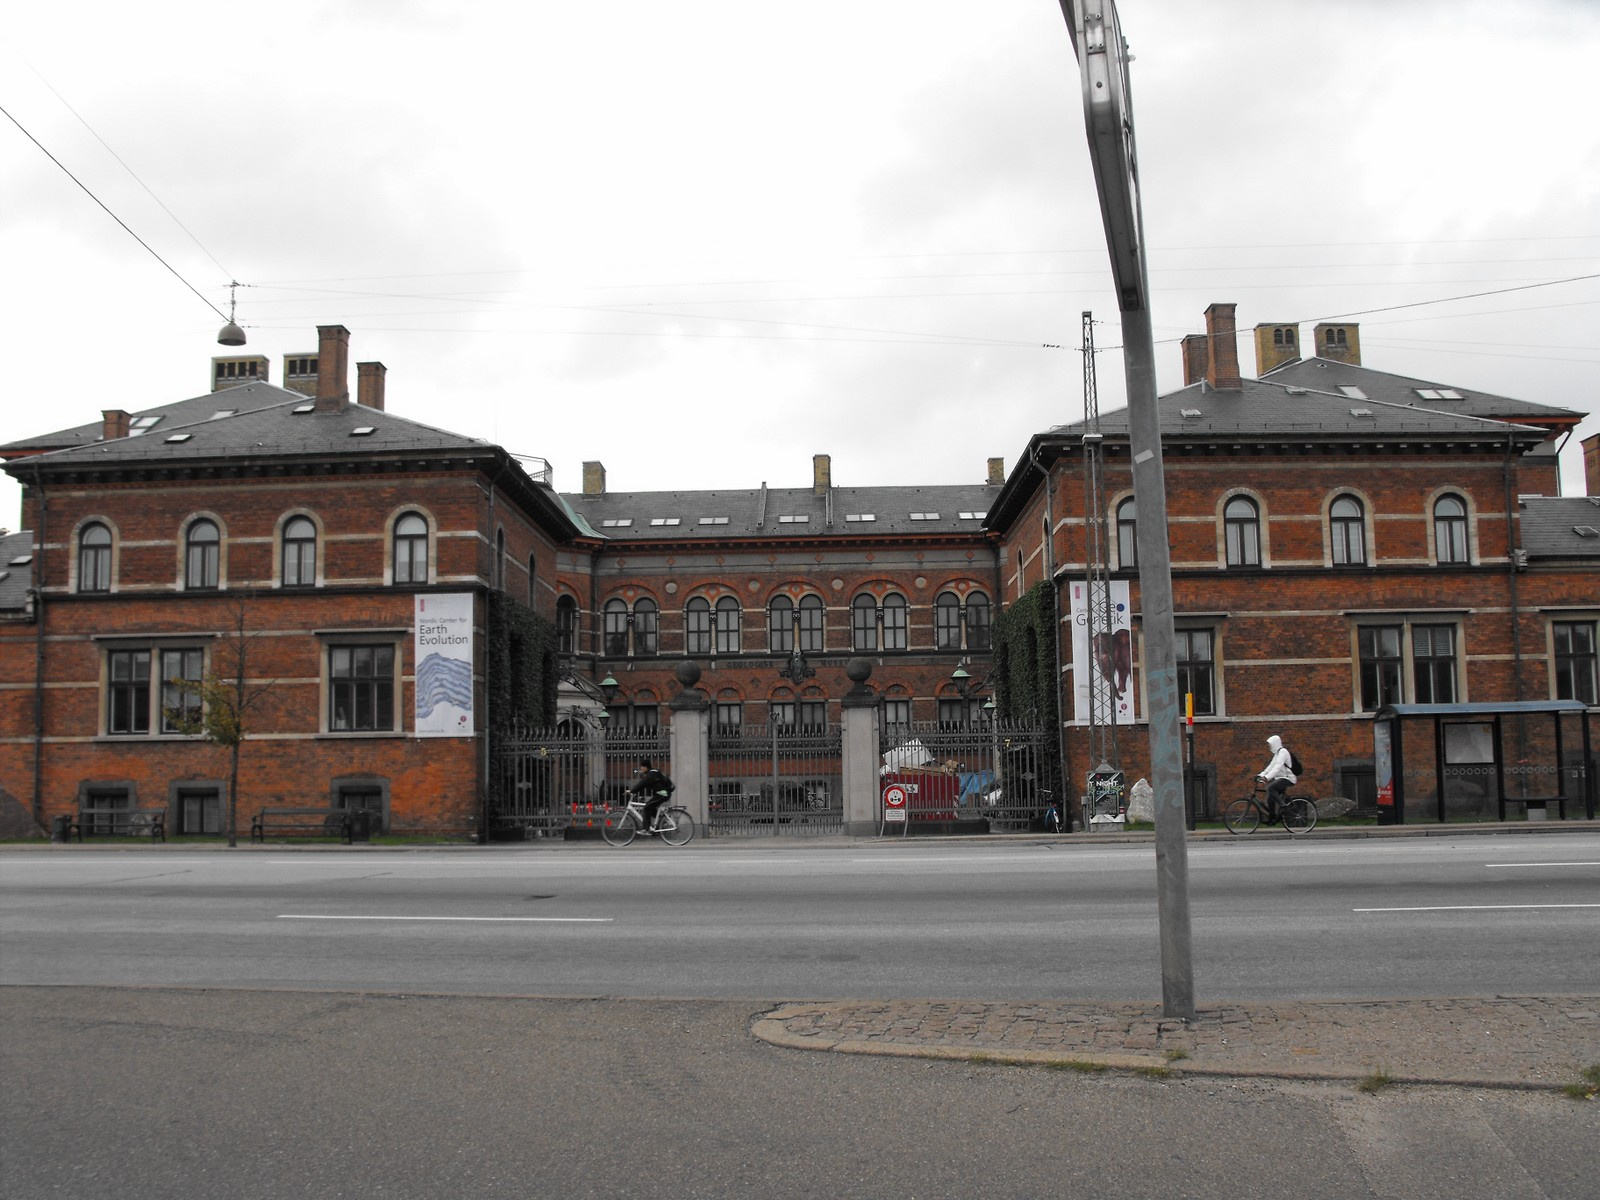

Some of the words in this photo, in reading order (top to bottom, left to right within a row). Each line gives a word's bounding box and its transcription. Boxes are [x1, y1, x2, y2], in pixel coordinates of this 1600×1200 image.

[459, 616, 468, 624] for
[419, 624, 448, 635] Earth
[419, 634, 469, 646] Evolution
[1004, 739, 1011, 748] 7
